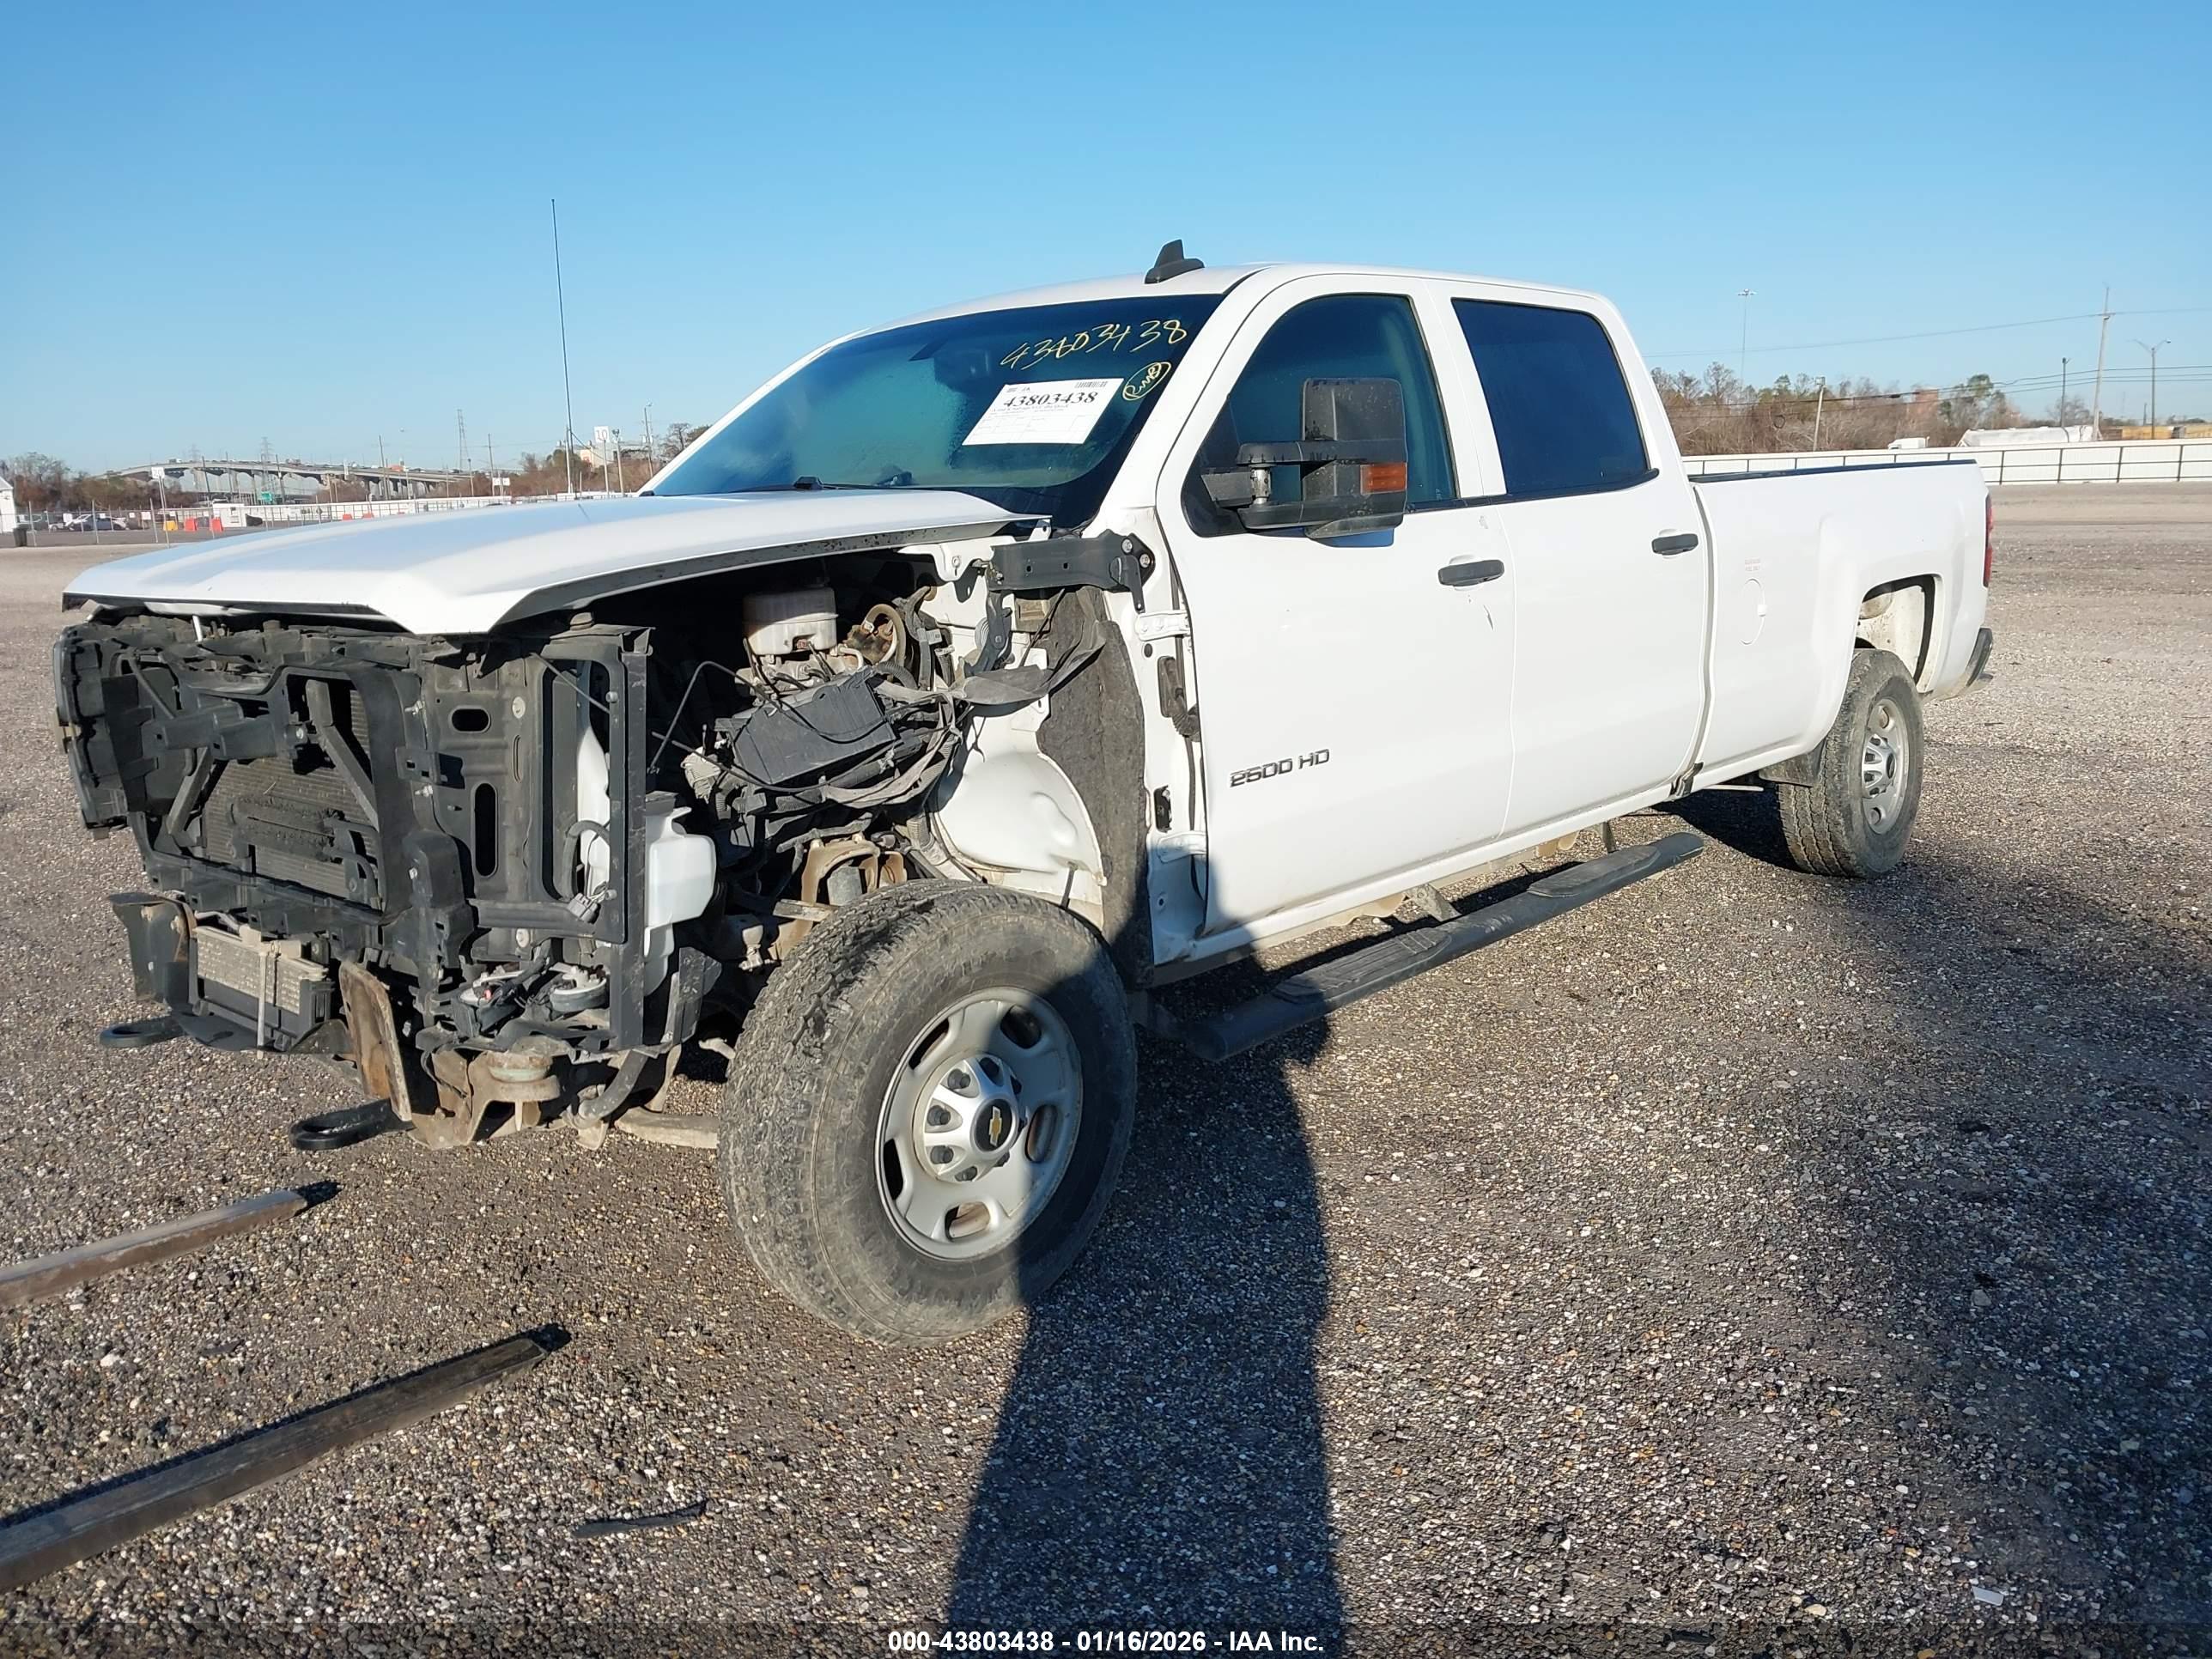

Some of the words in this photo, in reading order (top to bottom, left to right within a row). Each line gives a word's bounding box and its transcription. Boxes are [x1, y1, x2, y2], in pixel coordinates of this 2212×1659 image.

[1003, 391, 1098, 407] 43803438
[1230, 758, 1293, 787] 2500
[1298, 749, 1330, 769] HD
